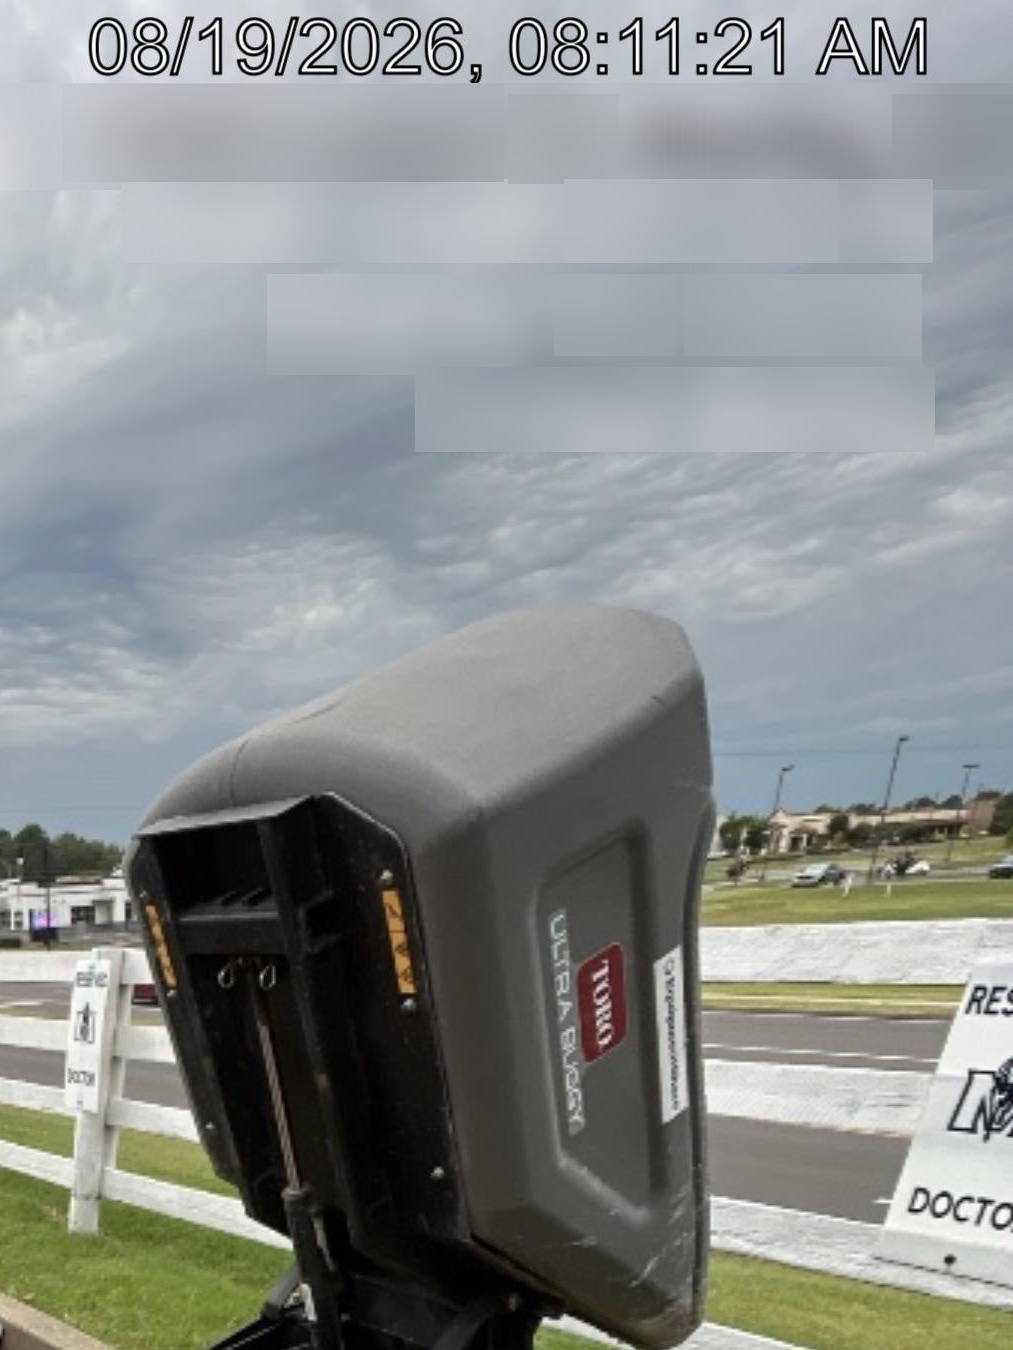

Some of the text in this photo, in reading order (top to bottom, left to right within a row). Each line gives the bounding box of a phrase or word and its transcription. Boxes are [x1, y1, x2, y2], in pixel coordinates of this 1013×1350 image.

[549, 911, 586, 1127] ULTRA BUGGY
[591, 958, 614, 1048] TORO
[907, 1186, 1013, 1233] DOCTO
